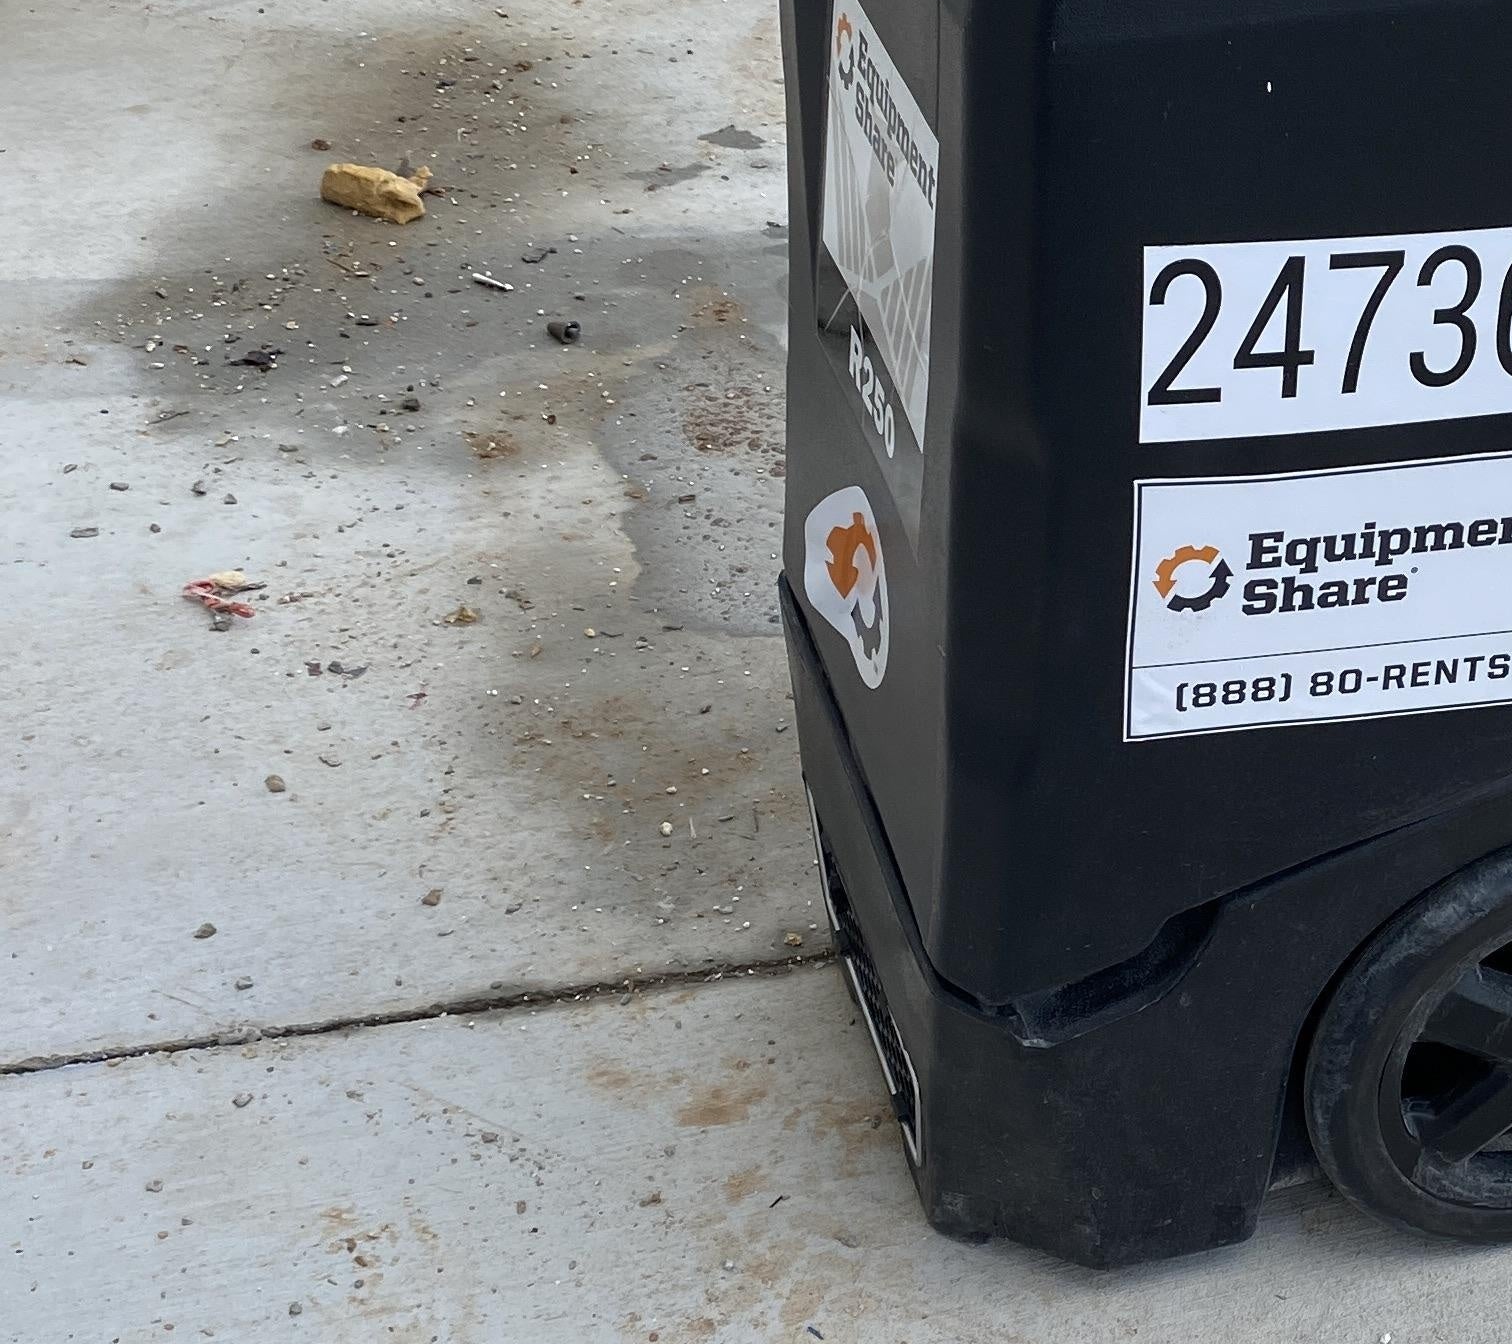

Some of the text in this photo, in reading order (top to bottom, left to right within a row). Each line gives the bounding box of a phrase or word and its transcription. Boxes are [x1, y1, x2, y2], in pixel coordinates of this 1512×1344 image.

[855, 80, 895, 188] Share
[857, 29, 936, 210] Equipment
[849, 324, 896, 459] R250
[1242, 572, 1409, 616] Share
[1175, 652, 1511, 713] (888) 80-RENTS
